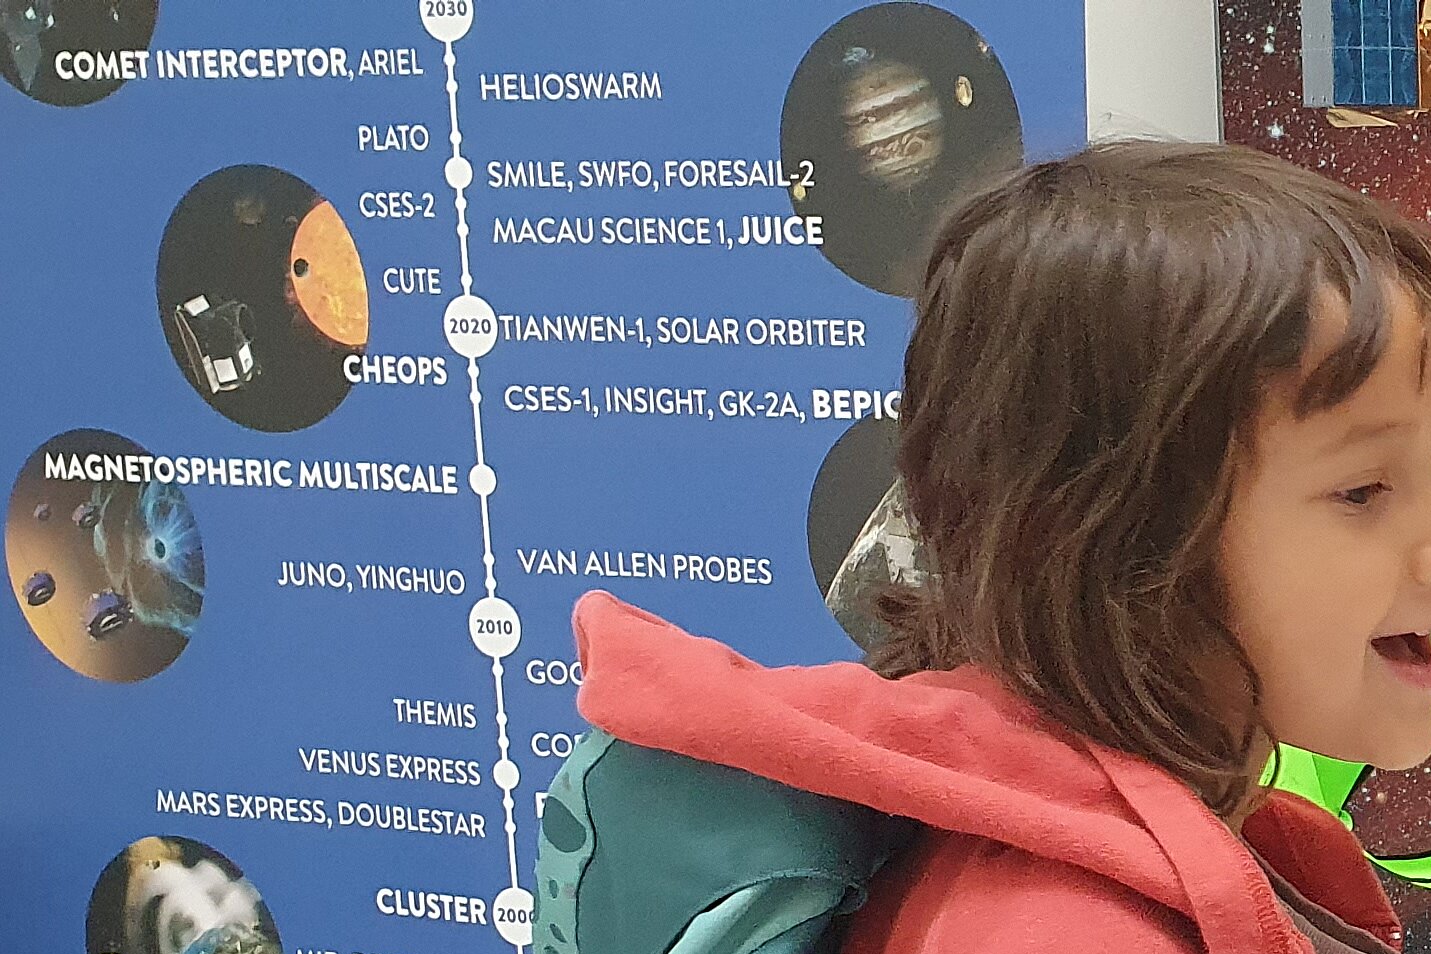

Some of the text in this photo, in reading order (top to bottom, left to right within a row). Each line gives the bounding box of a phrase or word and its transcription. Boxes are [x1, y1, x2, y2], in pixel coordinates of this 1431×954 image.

[426, 0, 467, 17] 2030
[55, 47, 424, 81] COMET INTERCEPTOR, ARIEL
[480, 71, 662, 101] HELIOSWARM
[358, 124, 429, 151] PLATO
[486, 160, 815, 193] SMILE, SWFO, FORESAIL-2
[359, 191, 436, 218] CSES-2
[492, 215, 824, 250] MACAU SCIENCE 1, JUICE
[383, 267, 442, 295] CUTE
[449, 318, 491, 334] 2020
[500, 316, 866, 348] TIANWEN-1, SOLAR ORBITER
[343, 354, 448, 386] CHEOPS
[504, 385, 599, 418] CSES-1,
[604, 386, 714, 421] INSIGHT,
[718, 390, 806, 424] GK-2A,
[45, 452, 459, 495] MAGNETOSPHERIC MULTISCALE
[277, 561, 466, 595] JUNO, YINGHUO
[516, 548, 772, 585] VAN ALLEN PROBES
[476, 619, 513, 635] 2010
[392, 698, 477, 729] THEMIS
[531, 732, 582, 758] CO
[298, 748, 481, 785] VENUS EXPRESS
[156, 789, 486, 838] MARS EXPRESS, DOUBLESTAR
[376, 887, 487, 925] CLUSTER
